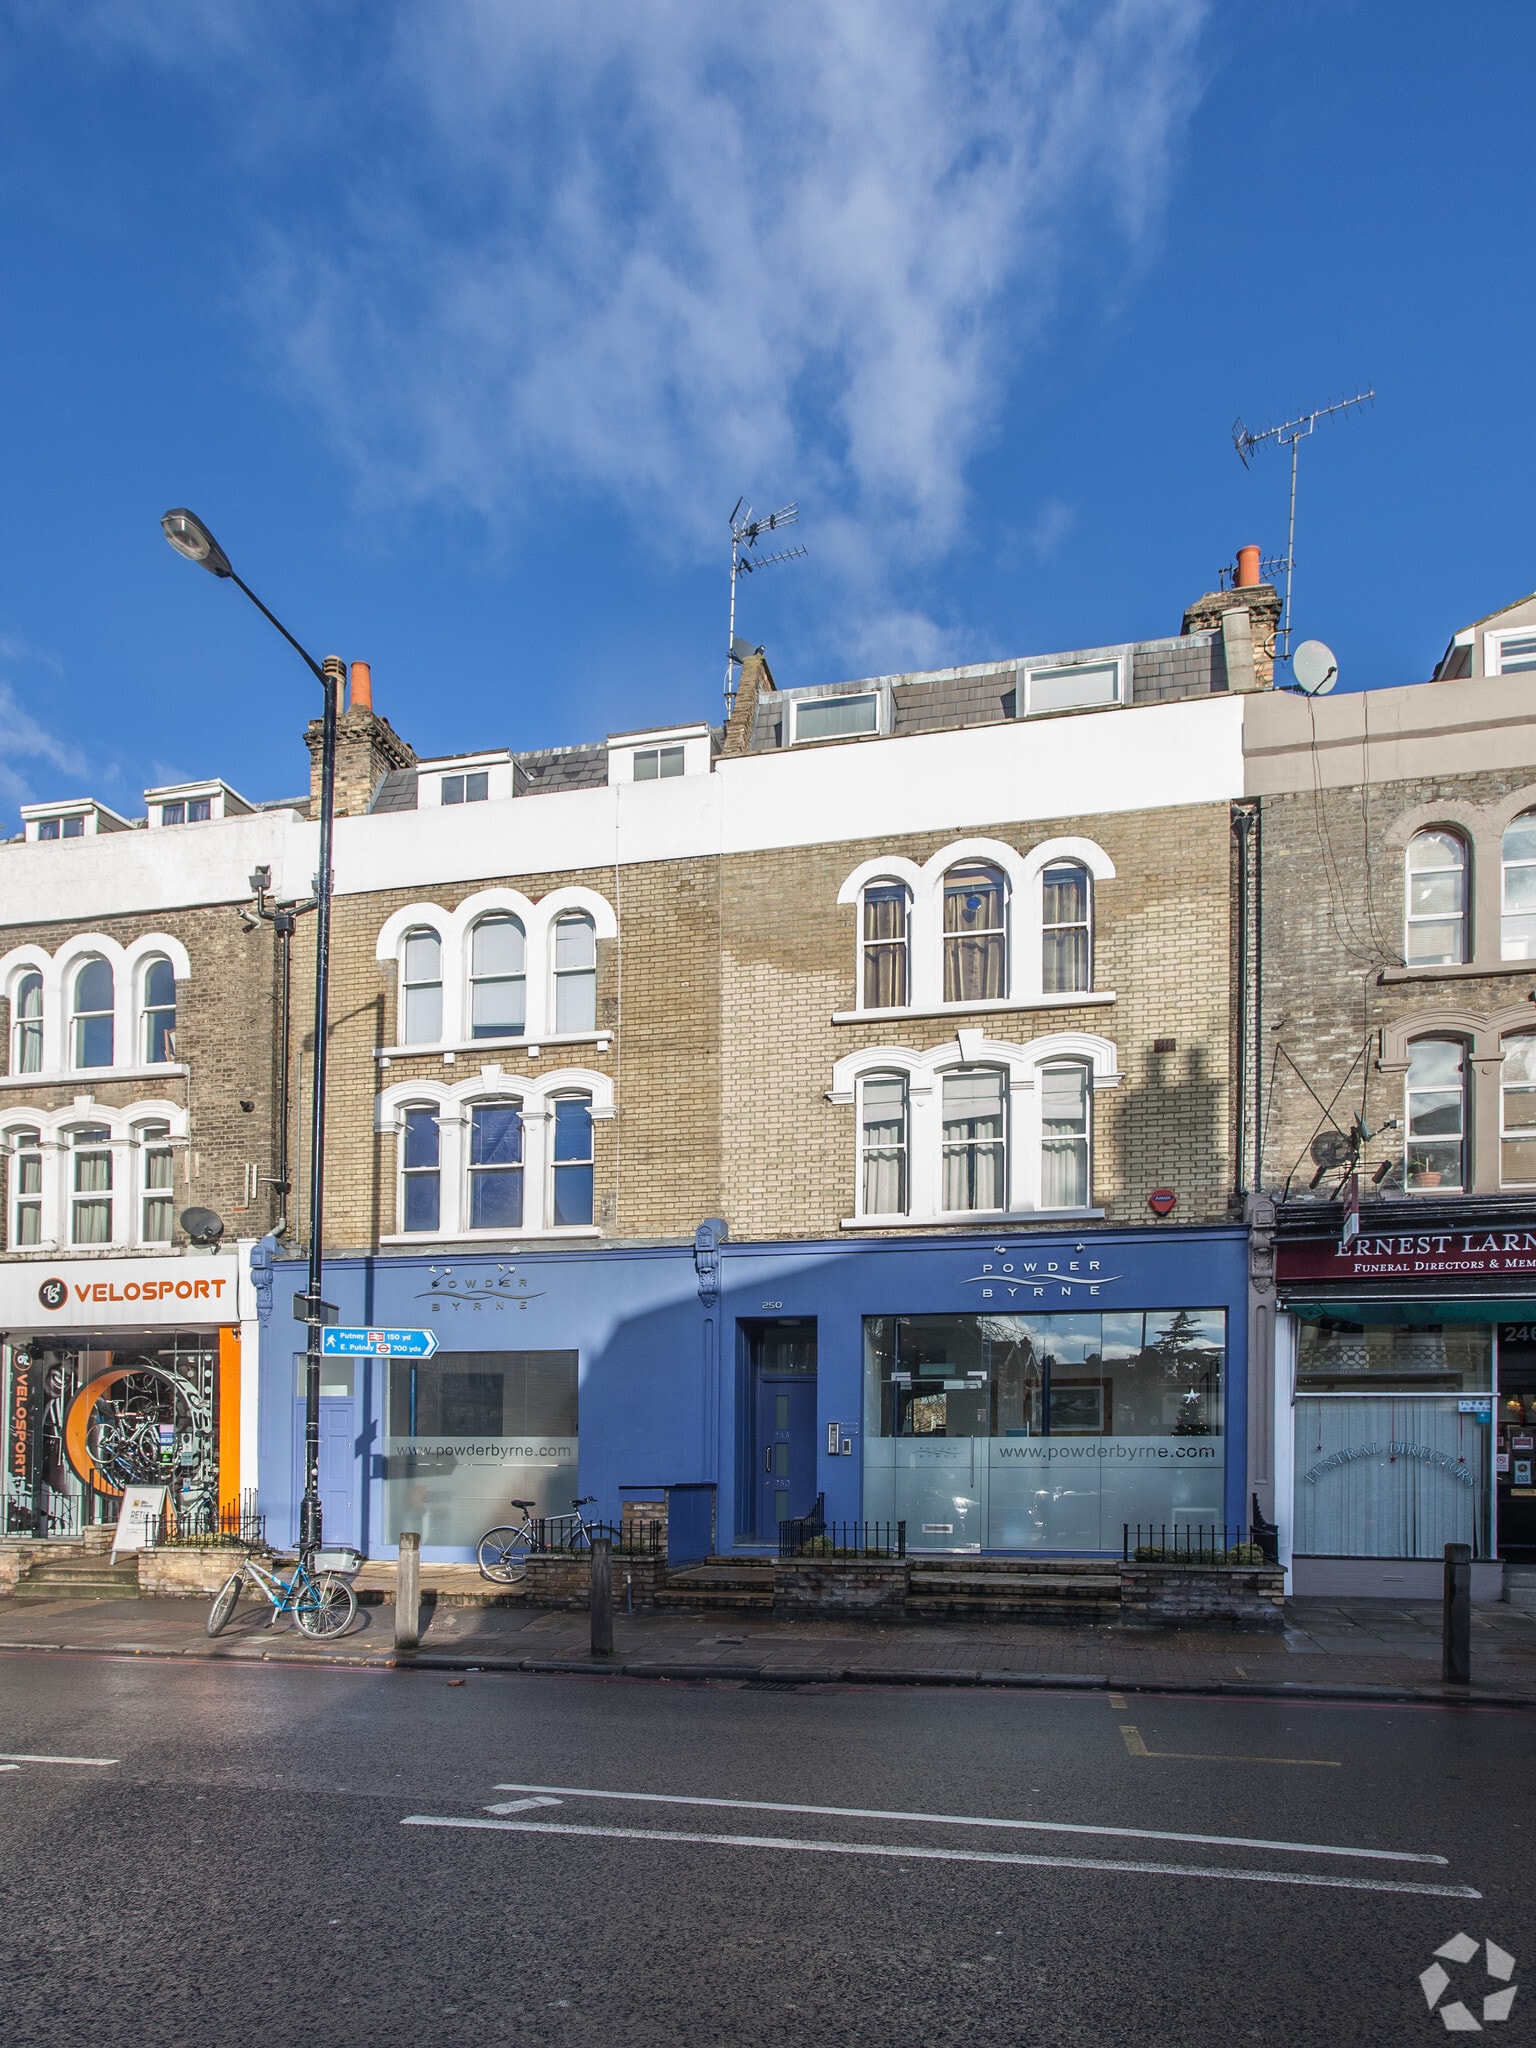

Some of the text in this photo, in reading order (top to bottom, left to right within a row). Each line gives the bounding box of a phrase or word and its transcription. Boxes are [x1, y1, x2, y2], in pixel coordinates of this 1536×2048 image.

[1335, 1233, 1536, 1256] ERNEST LARN
[983, 1261, 1100, 1273] POWDER
[1354, 1257, 1536, 1272] FUNERAL DIRECTORS & MEM
[74, 1279, 226, 1302] VELOSPORT
[431, 1279, 528, 1289] POWDER
[982, 1286, 1100, 1298] BYRNE
[431, 1301, 528, 1311] BYRNE
[762, 1301, 783, 1309] 250
[340, 1332, 364, 1340] Putney
[349, 1344, 374, 1352] Putney
[409, 1345, 421, 1353] yds
[14, 1373, 28, 1476] VELOSPORT
[397, 1443, 571, 1460] www.powderbyrne.com
[1000, 1444, 1215, 1461] www.powderbyrne.com
[1304, 1441, 1479, 1489] FUNERAL DIRECTORS
